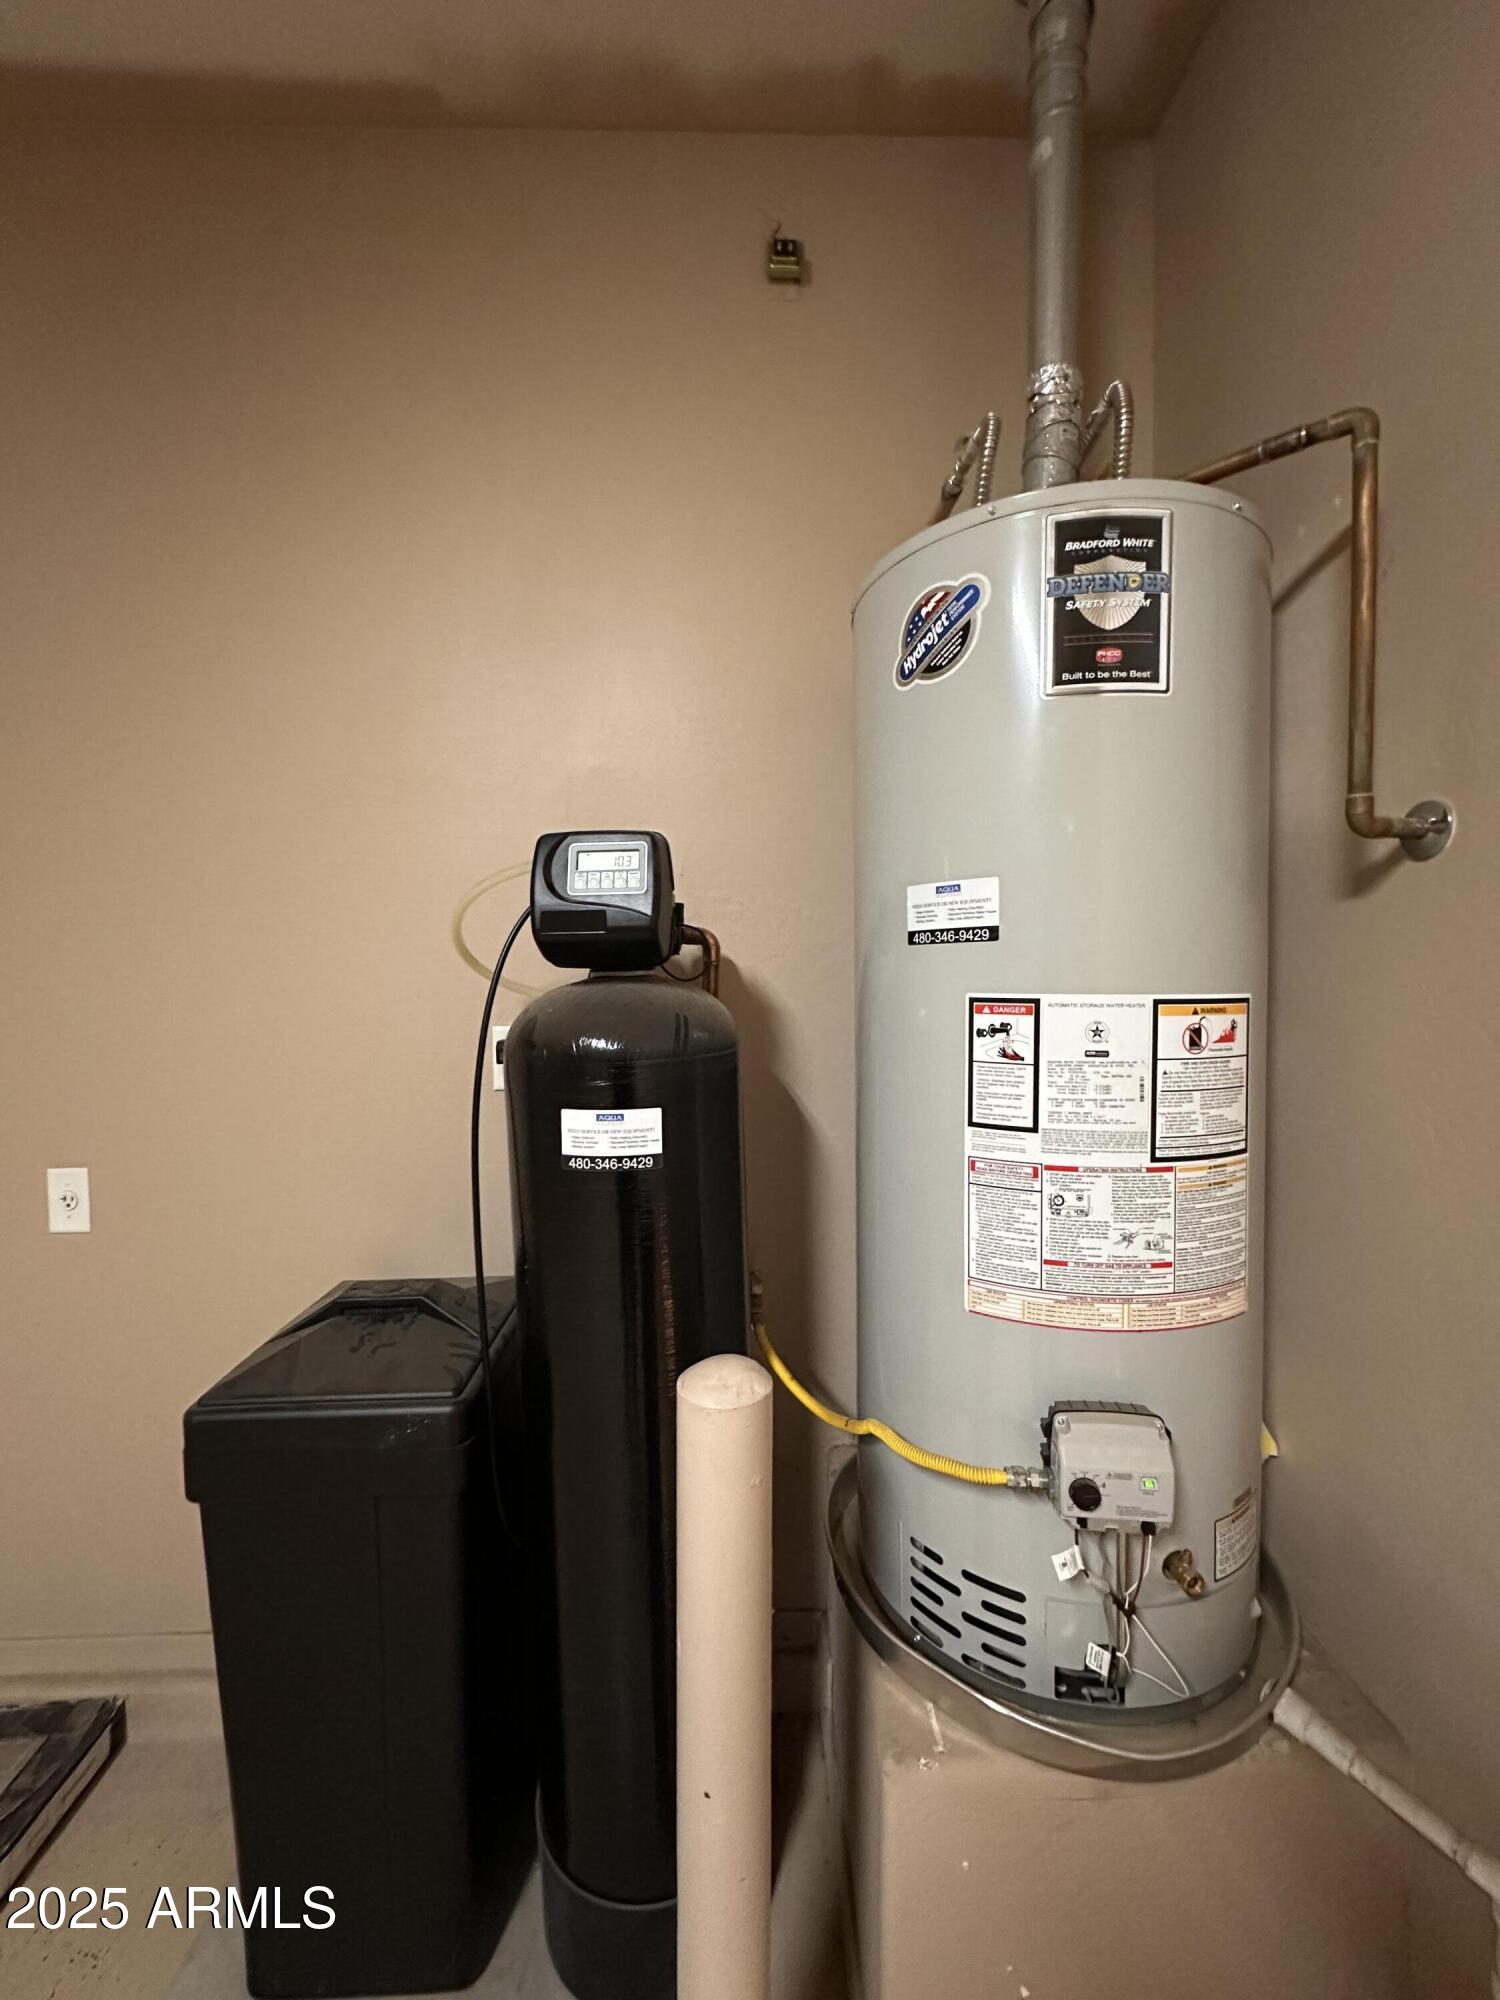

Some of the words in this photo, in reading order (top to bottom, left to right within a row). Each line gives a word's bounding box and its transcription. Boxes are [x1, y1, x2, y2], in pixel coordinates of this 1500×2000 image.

[1065, 539, 1120, 551] BRADFORD
[1123, 538, 1154, 547] WHITE
[1047, 571, 1170, 597] DEFENDER
[1065, 600, 1107, 610] SAFETY
[1109, 599, 1152, 608] SYSTEM
[903, 613, 950, 675] Hydrojet
[1062, 672, 1083, 681] Built
[1098, 670, 1110, 679] be
[1112, 670, 1127, 678] the
[1130, 670, 1151, 678] Best
[912, 929, 990, 944] 480-346-9429
[992, 1006, 1026, 1014] DANGER
[568, 1156, 654, 1170] 480-346-9429
